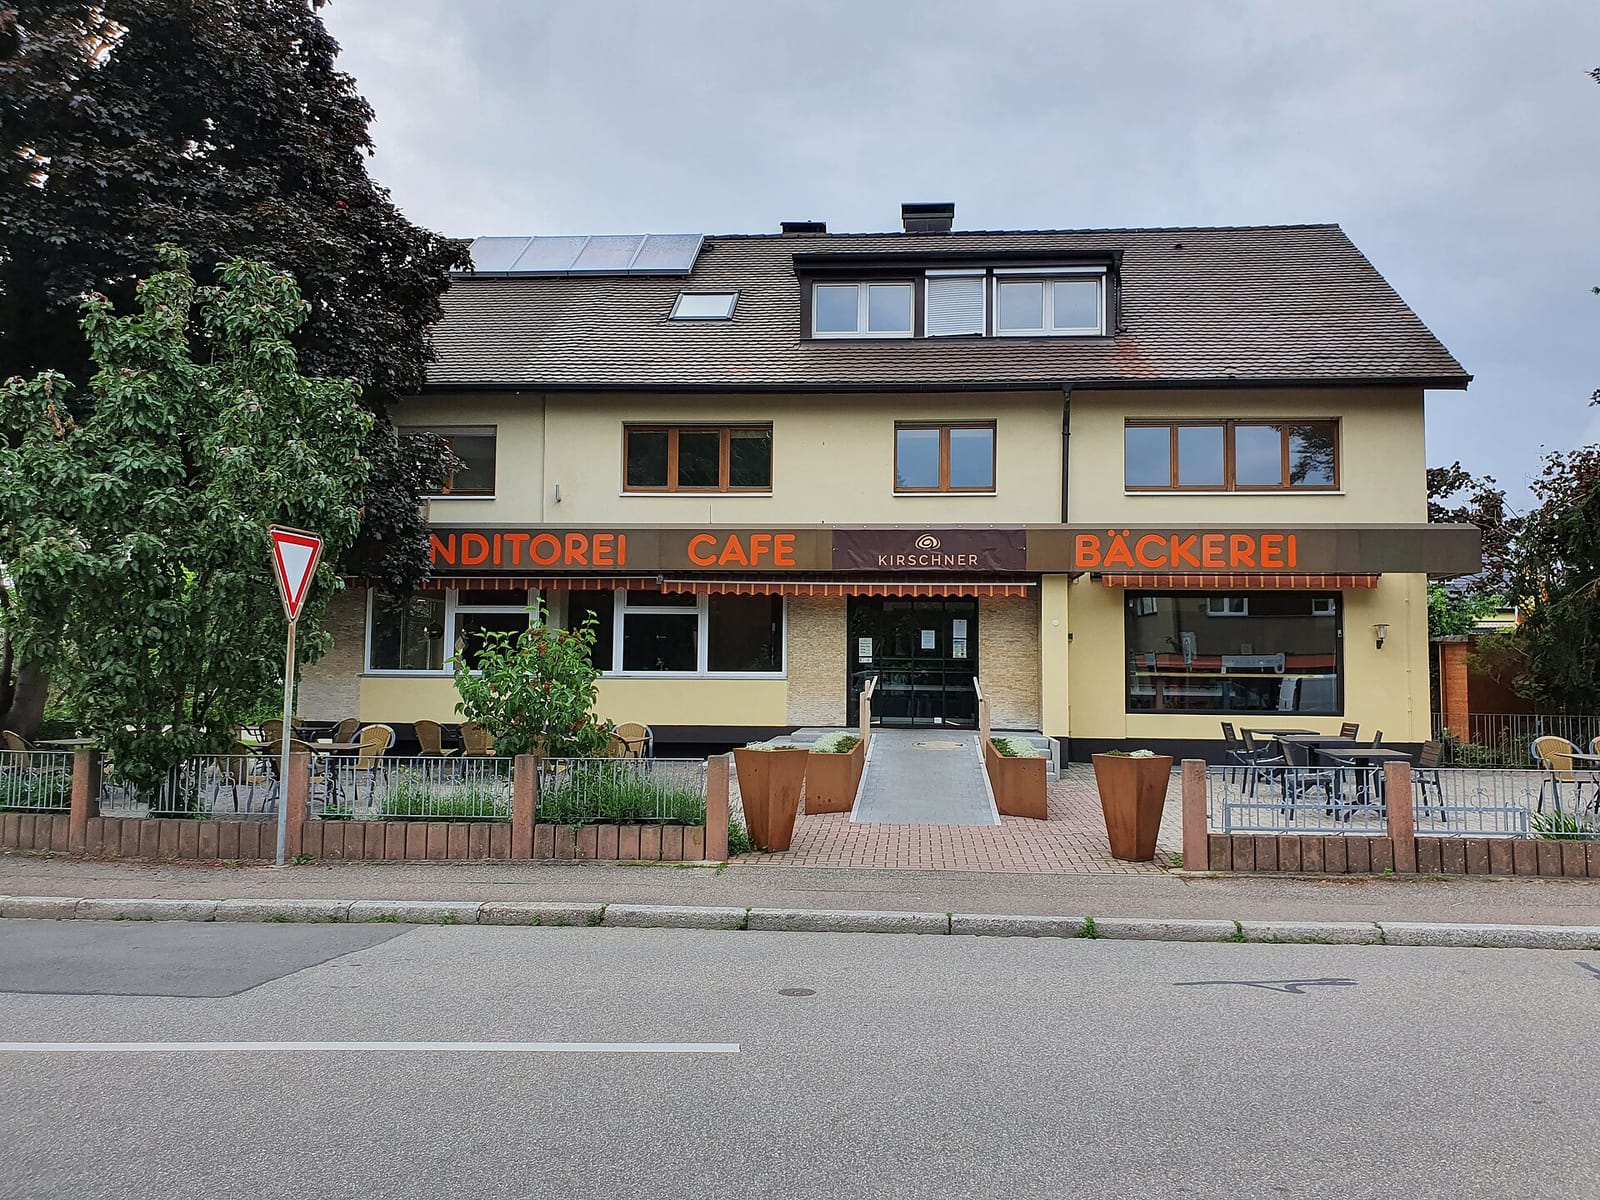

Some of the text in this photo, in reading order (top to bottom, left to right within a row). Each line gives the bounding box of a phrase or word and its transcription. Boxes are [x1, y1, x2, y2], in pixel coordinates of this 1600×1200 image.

[429, 533, 796, 567] NDITOREI CAFE
[878, 554, 978, 566] KIRSCHNER
[1075, 529, 1297, 568] BÄCKEREI
